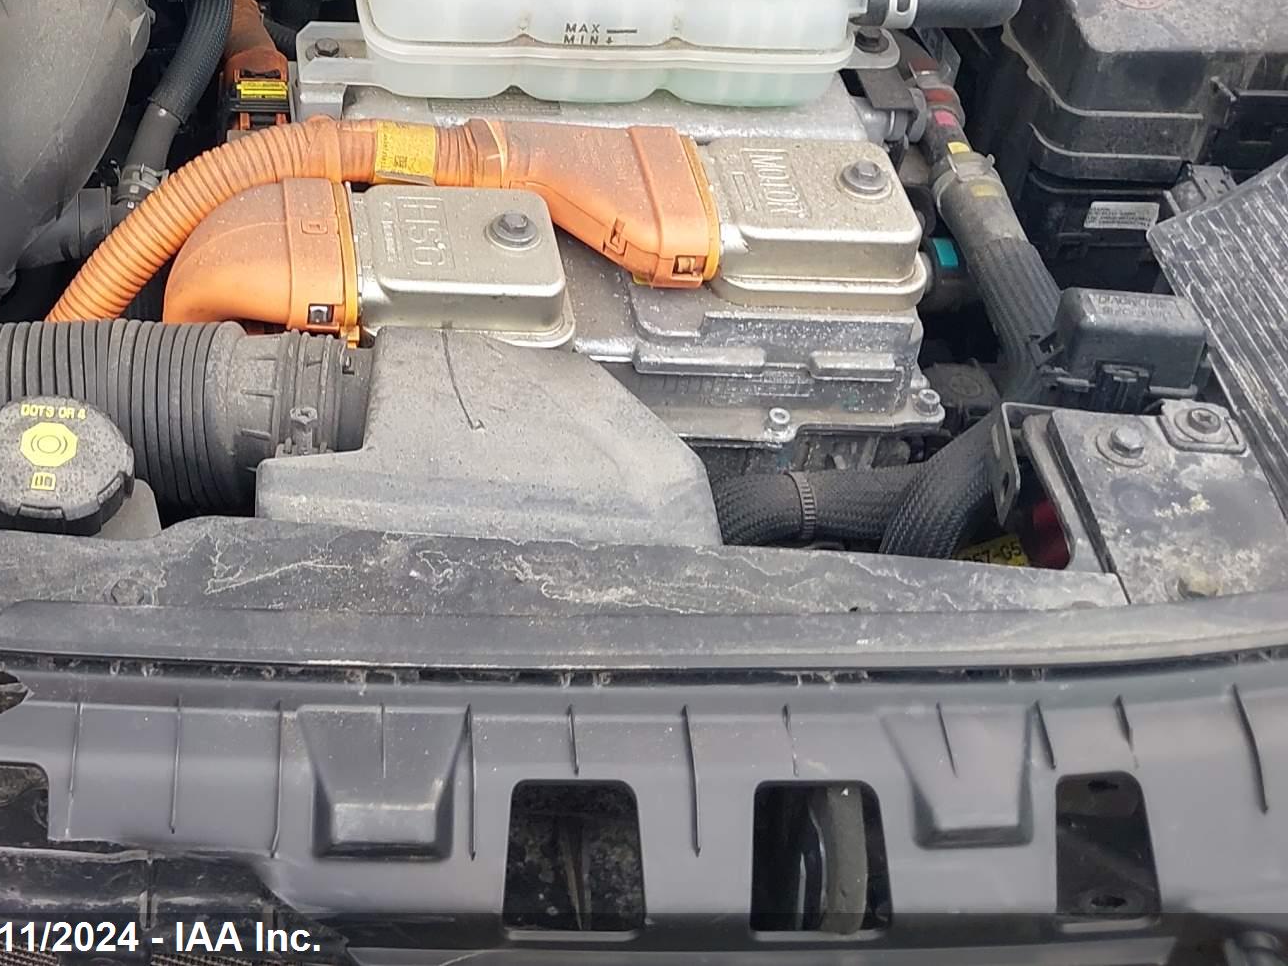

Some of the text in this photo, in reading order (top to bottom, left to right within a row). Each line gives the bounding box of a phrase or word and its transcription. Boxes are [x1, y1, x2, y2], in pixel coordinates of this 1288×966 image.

[565, 22, 600, 34] MAX
[563, 33, 599, 45] MIN
[748, 153, 804, 216] MOTOR
[20, 403, 55, 419] DOT3
[77, 408, 87, 421] 4
